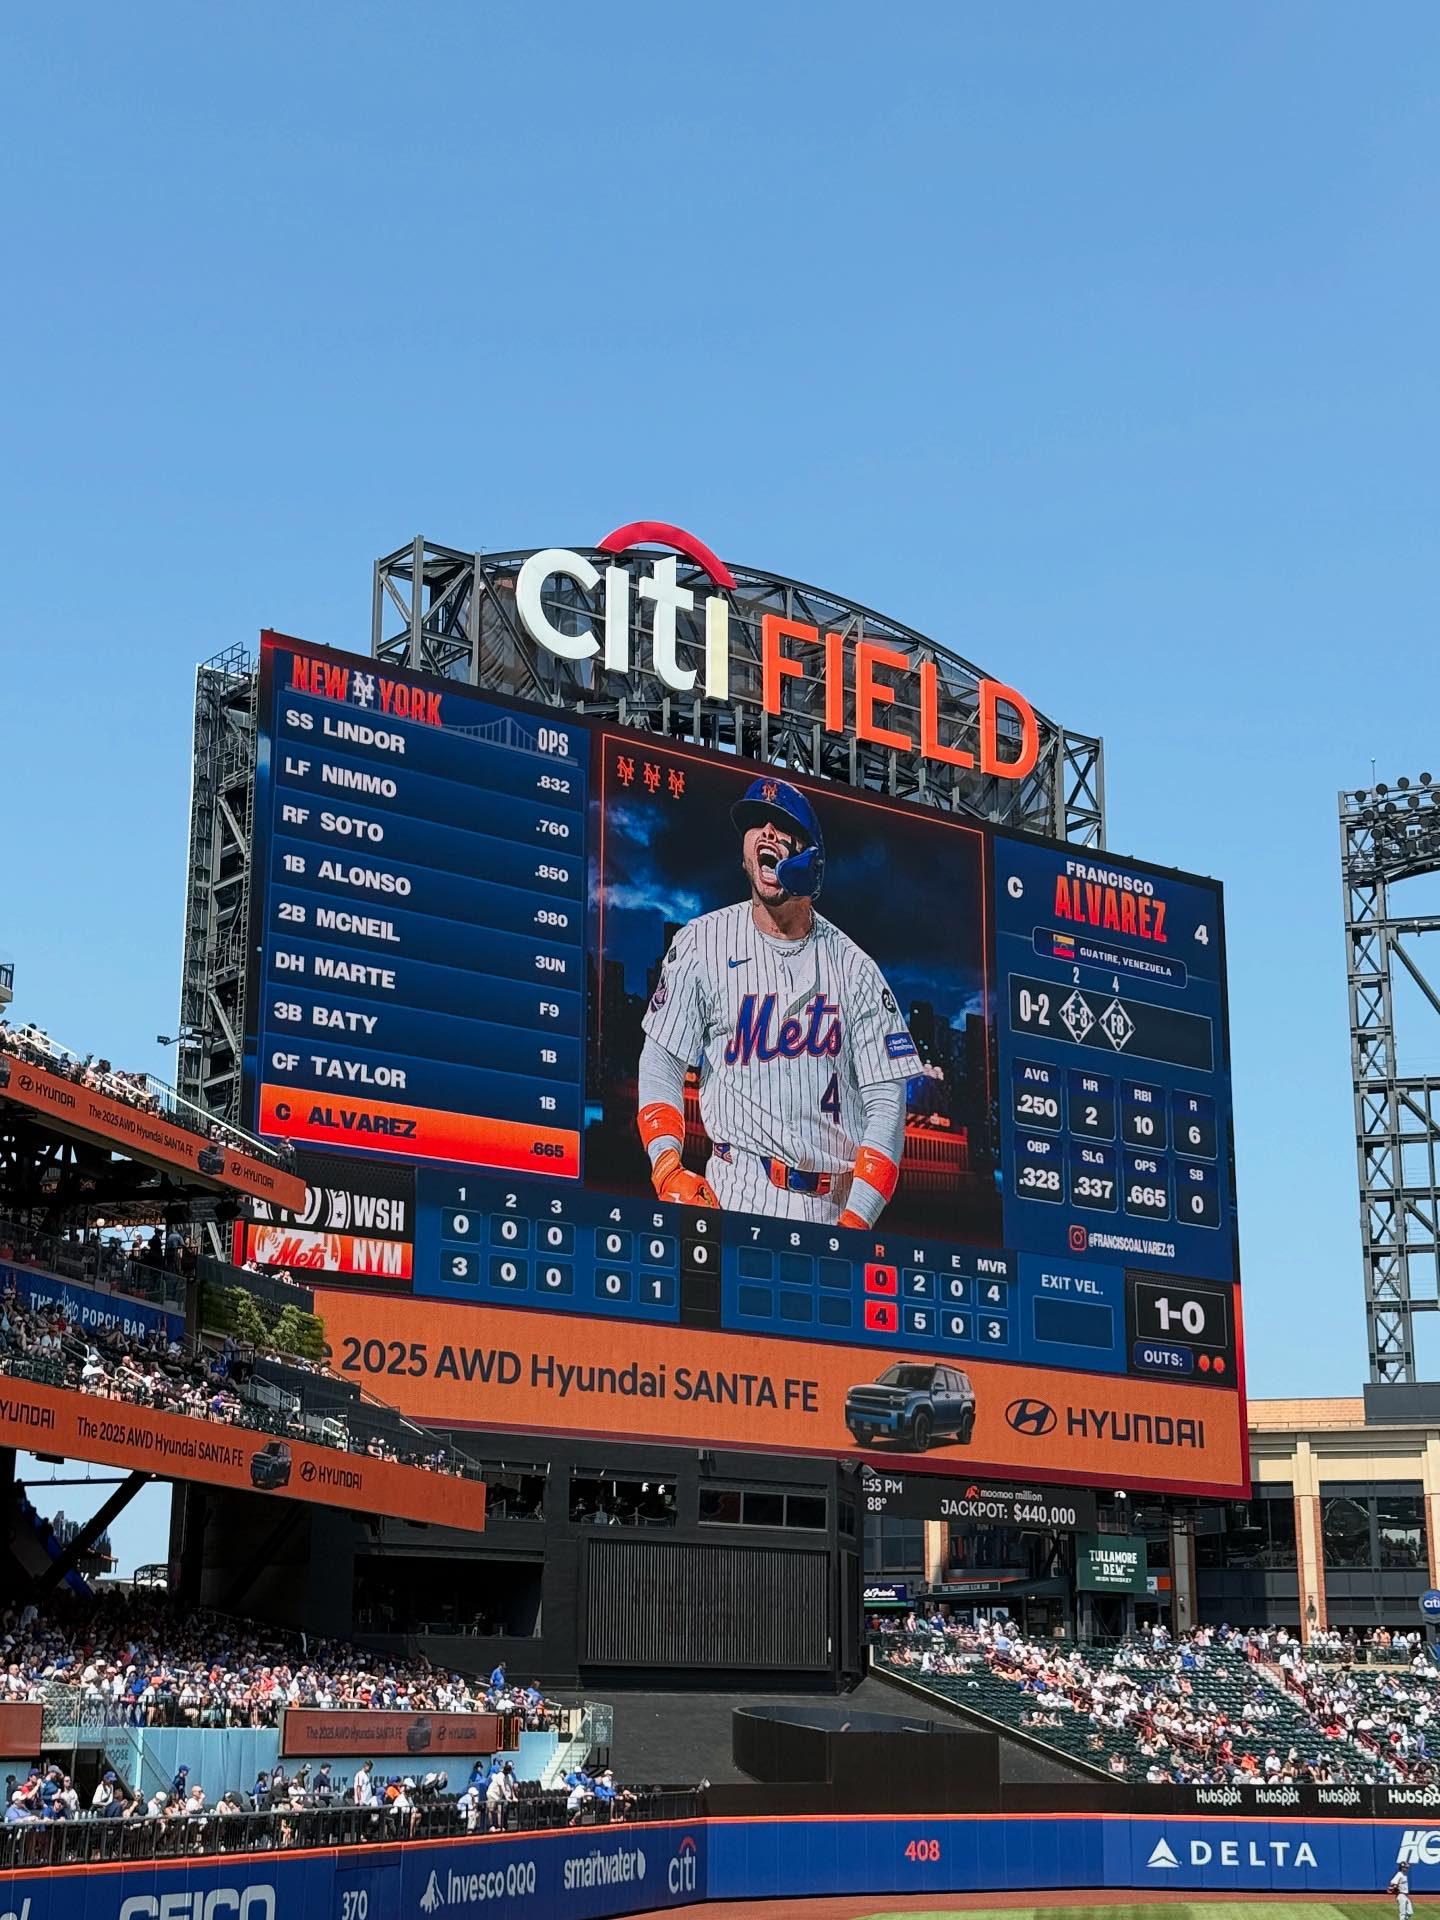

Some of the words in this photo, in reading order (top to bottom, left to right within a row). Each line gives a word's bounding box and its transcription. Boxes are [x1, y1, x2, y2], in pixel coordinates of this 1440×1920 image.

[516, 549, 729, 700] citi
[762, 614, 1039, 779] FIELD
[292, 655, 349, 701] NEW
[379, 678, 443, 728] YORK
[286, 710, 313, 730] SS
[323, 717, 405, 754] LINDOR
[537, 727, 569, 757] OPS
[285, 757, 311, 776] LF
[322, 763, 397, 798] NIMMO
[537, 776, 570, 795] .832
[282, 804, 310, 825] RF
[320, 811, 384, 842] SOTO
[535, 818, 570, 838] .760
[283, 854, 306, 873] 1B
[318, 860, 412, 897] ALONSO
[535, 864, 569, 883] .850
[1007, 876, 1024, 899] C
[1066, 860, 1154, 897] FRANCISCO
[278, 902, 306, 923] 2B
[316, 908, 401, 942] MCNEIL
[533, 910, 569, 928] .980
[1055, 875, 1168, 943] ALVAREZ
[1194, 924, 1209, 945] 4
[275, 951, 305, 973] DH
[314, 956, 396, 990] MARTE
[535, 955, 566, 973] 3UN
[1080, 947, 1121, 966] GUATIRE,
[1122, 957, 1172, 977] VENEZUELA
[1073, 966, 1080, 984] 2
[1112, 976, 1120, 993] 4
[273, 1002, 302, 1023] 3B
[312, 1006, 378, 1035] BATY
[539, 1002, 560, 1018] F9
[1019, 989, 1051, 1026] 0-2
[1068, 1004, 1089, 1029] 5-3
[1111, 1013, 1124, 1036] F8
[725, 992, 842, 1066] Mets
[272, 1051, 300, 1072] CF
[310, 1055, 406, 1089] TAYLOR
[540, 1049, 557, 1064] 1B
[35, 1081, 76, 1109] HYUNDAI
[539, 1096, 556, 1111] 1B
[820, 1074, 840, 1125] 4
[1024, 1067, 1049, 1083] AVG
[1082, 1078, 1099, 1093] HR
[1133, 1089, 1152, 1103] RBI
[1190, 1100, 1198, 1112] R
[102, 1110, 119, 1126] 2025
[119, 1117, 135, 1133] AWD
[136, 1123, 164, 1143] Hyundai
[164, 1135, 185, 1153] SANTA
[185, 1143, 194, 1157] FE
[275, 1103, 291, 1121] C
[308, 1106, 417, 1140] ALVAREZ
[1017, 1094, 1058, 1118] .250
[1085, 1106, 1098, 1126] 2
[1133, 1115, 1153, 1136] 10
[1188, 1126, 1201, 1145] 6
[1027, 1140, 1051, 1154] OBP
[1082, 1150, 1104, 1164] SLG
[1134, 1159, 1157, 1173] OPS
[1189, 1168, 1204, 1181] SB
[243, 1167, 274, 1189] HYUNDAI
[1019, 1167, 1060, 1191] .328
[1073, 1176, 1113, 1200] .337
[1127, 1185, 1167, 1208] .665
[1191, 1195, 1204, 1214] 0
[458, 1187, 467, 1202] 1
[506, 1193, 517, 1208] 2
[551, 1199, 563, 1214] 3
[609, 1208, 621, 1222] 4
[653, 1214, 664, 1227] 5
[696, 1219, 707, 1233] 6
[750, 1227, 761, 1241] 7
[790, 1233, 801, 1246] 8
[829, 1238, 840, 1251] 9
[875, 1244, 885, 1257] R
[914, 1250, 924, 1263] H
[952, 1256, 960, 1268] E
[977, 1259, 1007, 1275] MVR
[353, 1195, 405, 1231] WSH
[453, 1214, 470, 1235] 0
[501, 1220, 518, 1241] 0
[547, 1226, 563, 1246] 0
[606, 1234, 622, 1253] 0
[650, 1240, 665, 1259] 0
[693, 1245, 708, 1264] 0
[874, 1270, 888, 1287] 0
[913, 1275, 926, 1292] 2
[950, 1280, 963, 1297] 0
[987, 1285, 1000, 1302] 4
[352, 1239, 402, 1274] NYM
[452, 1257, 468, 1277] 3
[500, 1262, 517, 1283] 0
[546, 1268, 562, 1287] 0
[606, 1275, 621, 1294] 0
[652, 1281, 662, 1298] 1
[874, 1308, 888, 1325] 4
[914, 1313, 927, 1330] 5
[951, 1317, 964, 1334] 0
[988, 1322, 1001, 1338] 3
[1041, 1275, 1071, 1291] EXIT
[1074, 1278, 1103, 1295] VEL.
[123, 1318, 145, 1340] BAR
[1155, 1298, 1205, 1334] 1-0
[1144, 1350, 1183, 1367] OUTS:
[341, 1337, 428, 1377] 2025
[434, 1345, 522, 1385] AWD
[531, 1354, 666, 1398] Hyundai
[674, 1367, 778, 1409] SANTA
[784, 1378, 819, 1413] FE
[0, 1398, 55, 1429] YUNDAI
[1067, 1406, 1205, 1449] HYUNDAI
[77, 1416, 98, 1438] The
[100, 1422, 125, 1442] 2025
[126, 1427, 153, 1449] AWD
[155, 1432, 198, 1458] Hyundai
[198, 1441, 231, 1464] SANTA
[232, 1449, 244, 1467] FE
[318, 1466, 362, 1490] HYUNDAI
[884, 1479, 903, 1494] PM
[981, 1488, 1014, 1500] moomoo
[1015, 1489, 1043, 1502] million
[941, 1499, 1008, 1519] JACKPOT:
[1013, 1503, 1076, 1526] $440,000
[1088, 1550, 1138, 1564] TULLAMORE
[1196, 1786, 1242, 1807] HubSpot
[1256, 1786, 1300, 1807] HubSpot
[1318, 1786, 1361, 1807] HubSpot
[1388, 1784, 1440, 1807] HubSpo
[904, 1839, 941, 1862] 408
[1190, 1840, 1318, 1867] DELTA
[447, 1868, 504, 1905] Invesco
[507, 1861, 536, 1897] QQQ
[564, 1847, 637, 1890] smartwater
[668, 1847, 696, 1894] citi
[342, 1889, 367, 1919] 370
